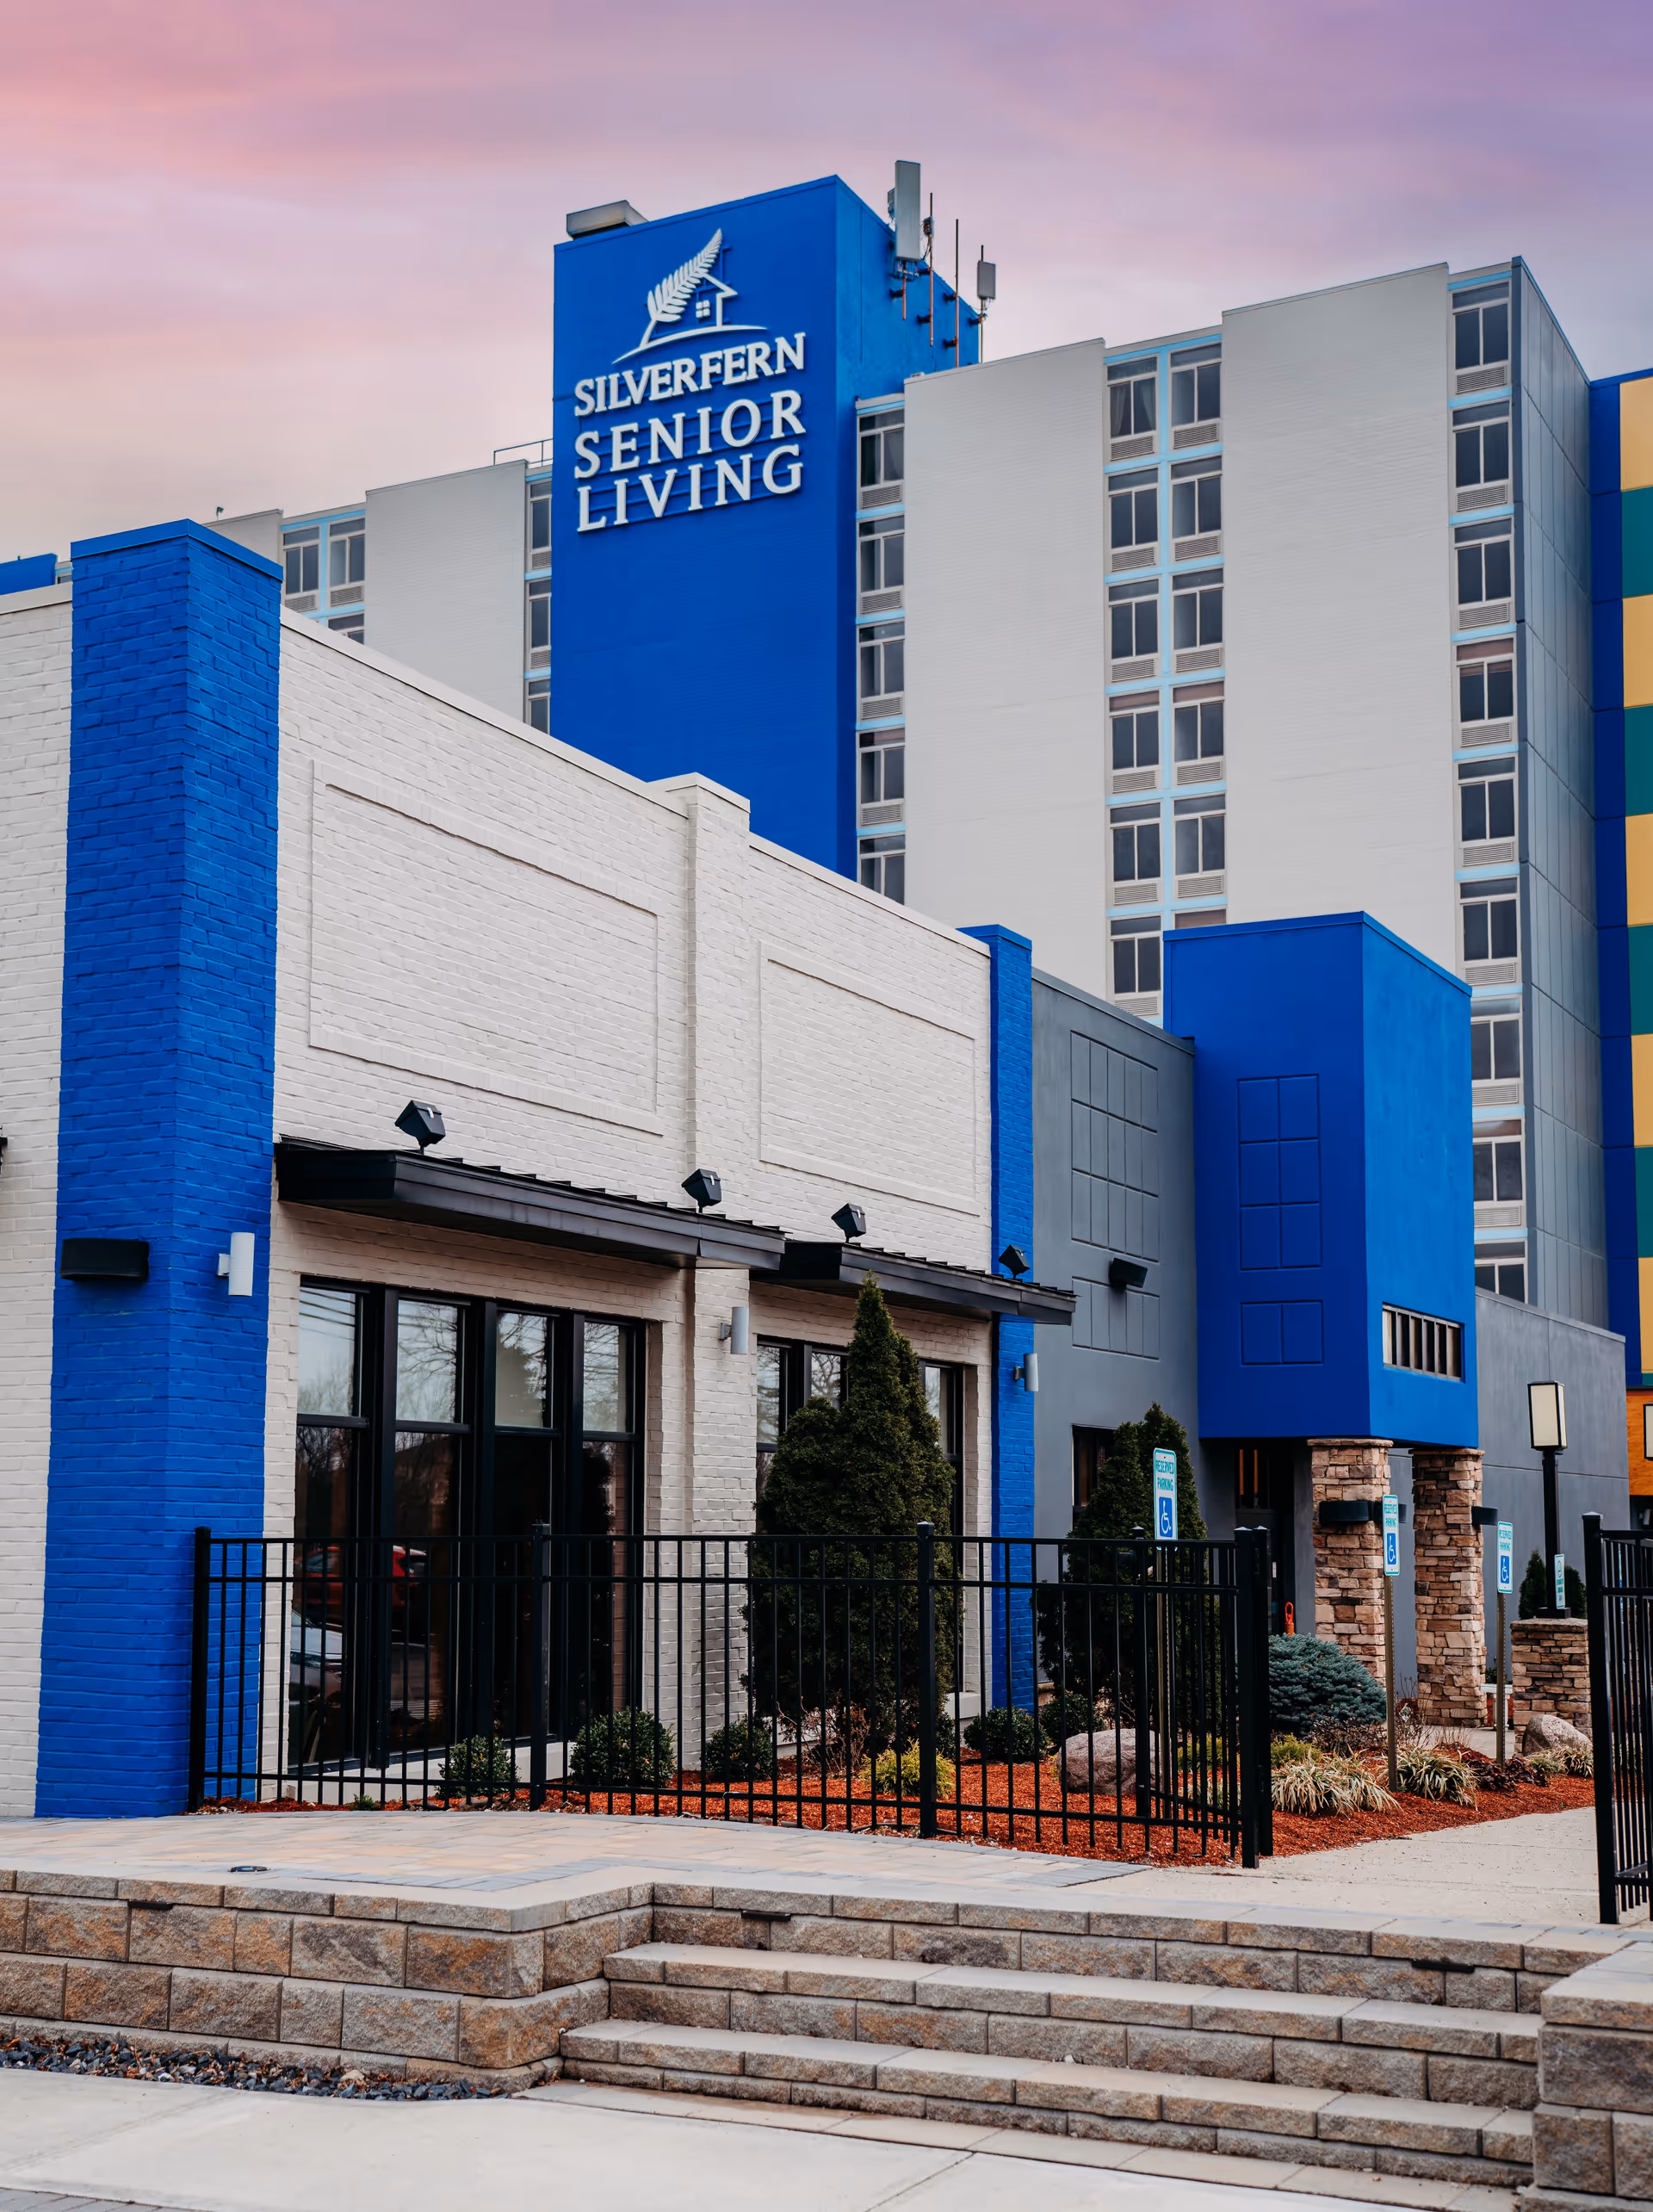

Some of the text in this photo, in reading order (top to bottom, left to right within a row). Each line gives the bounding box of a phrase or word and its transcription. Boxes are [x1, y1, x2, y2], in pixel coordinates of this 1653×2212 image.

[574, 332, 806, 417] SILVERFERN
[574, 390, 806, 478] SENIOR
[577, 444, 803, 532] LIVING
[1155, 1459, 1174, 1474] RESERVED
[1157, 1477, 1173, 1491] PARKING
